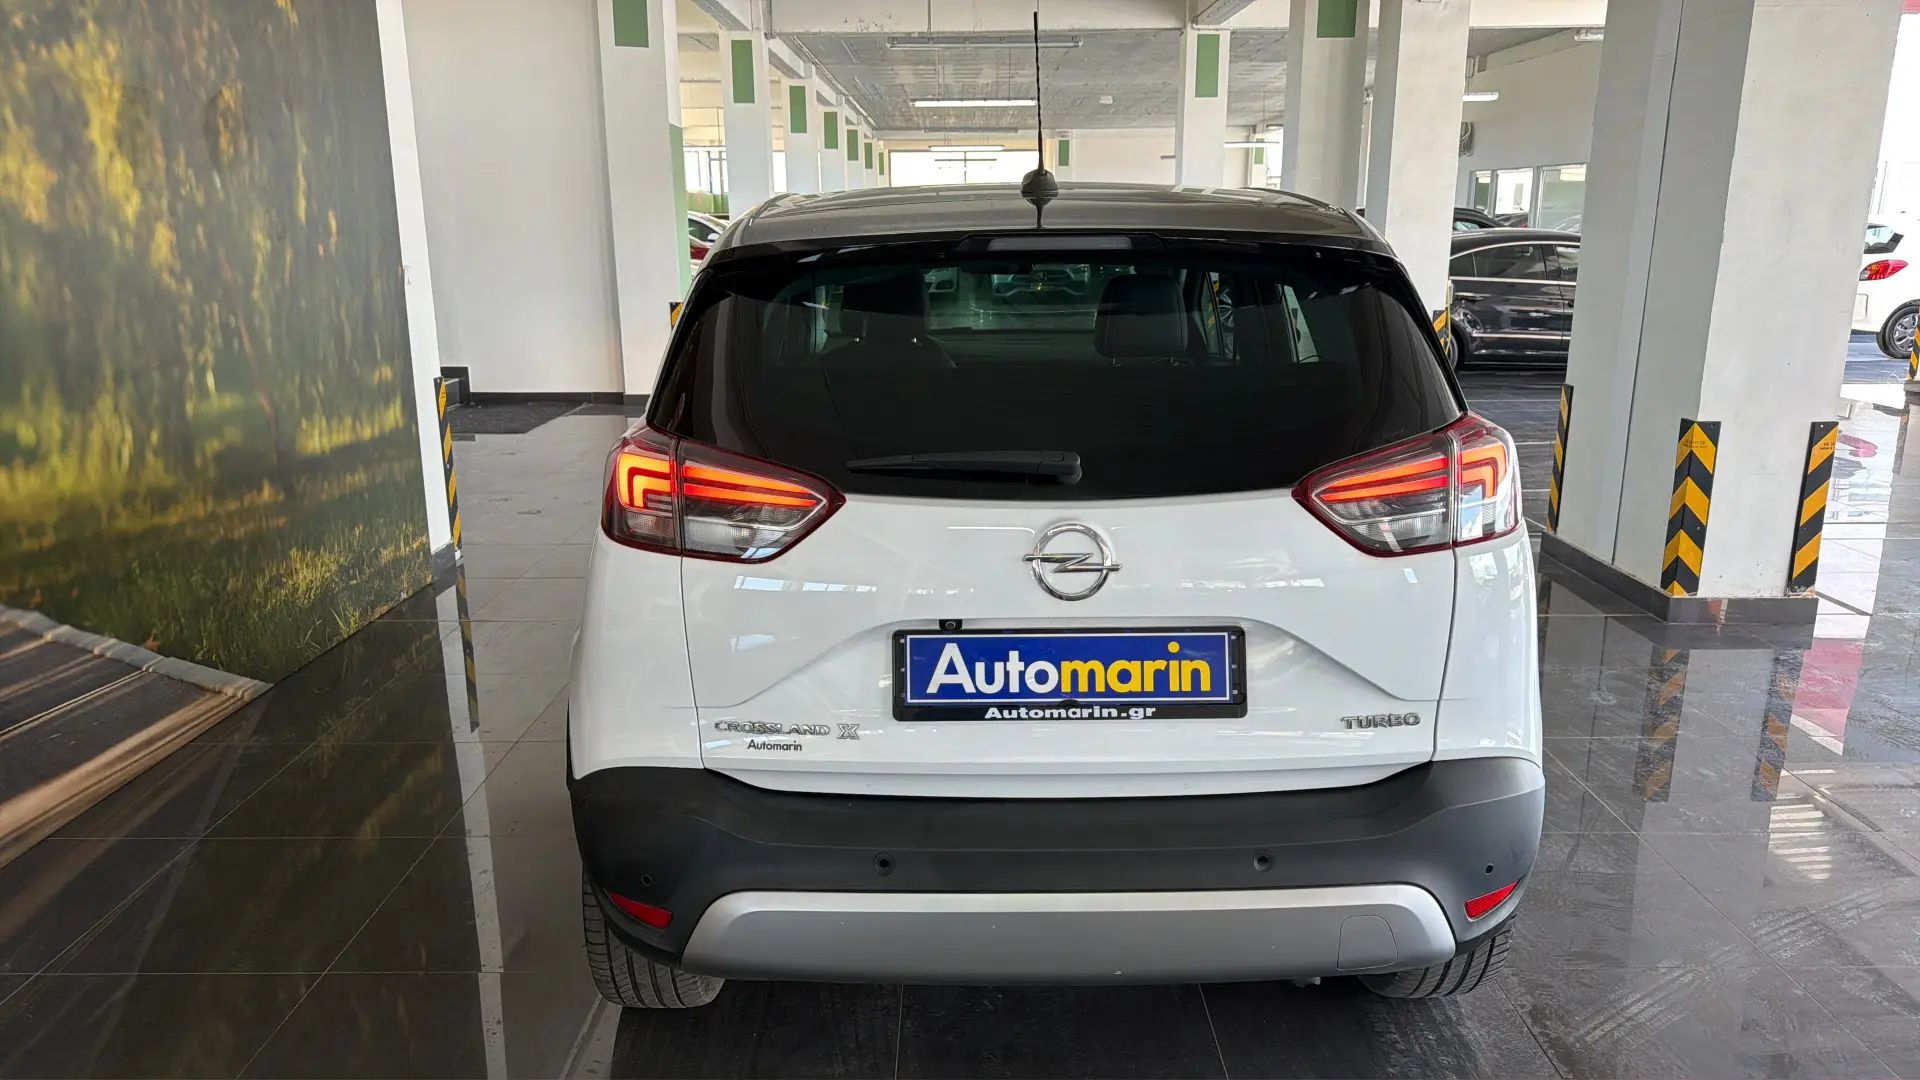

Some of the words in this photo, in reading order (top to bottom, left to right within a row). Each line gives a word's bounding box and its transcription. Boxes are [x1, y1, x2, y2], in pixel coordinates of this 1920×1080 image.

[926, 641, 1211, 694] Automarin
[984, 705, 1157, 719] Automarin.gr
[1340, 712, 1421, 729] TURBO
[714, 720, 831, 736] CROSSLAND
[837, 723, 860, 740] X
[747, 739, 802, 751] Automarin
